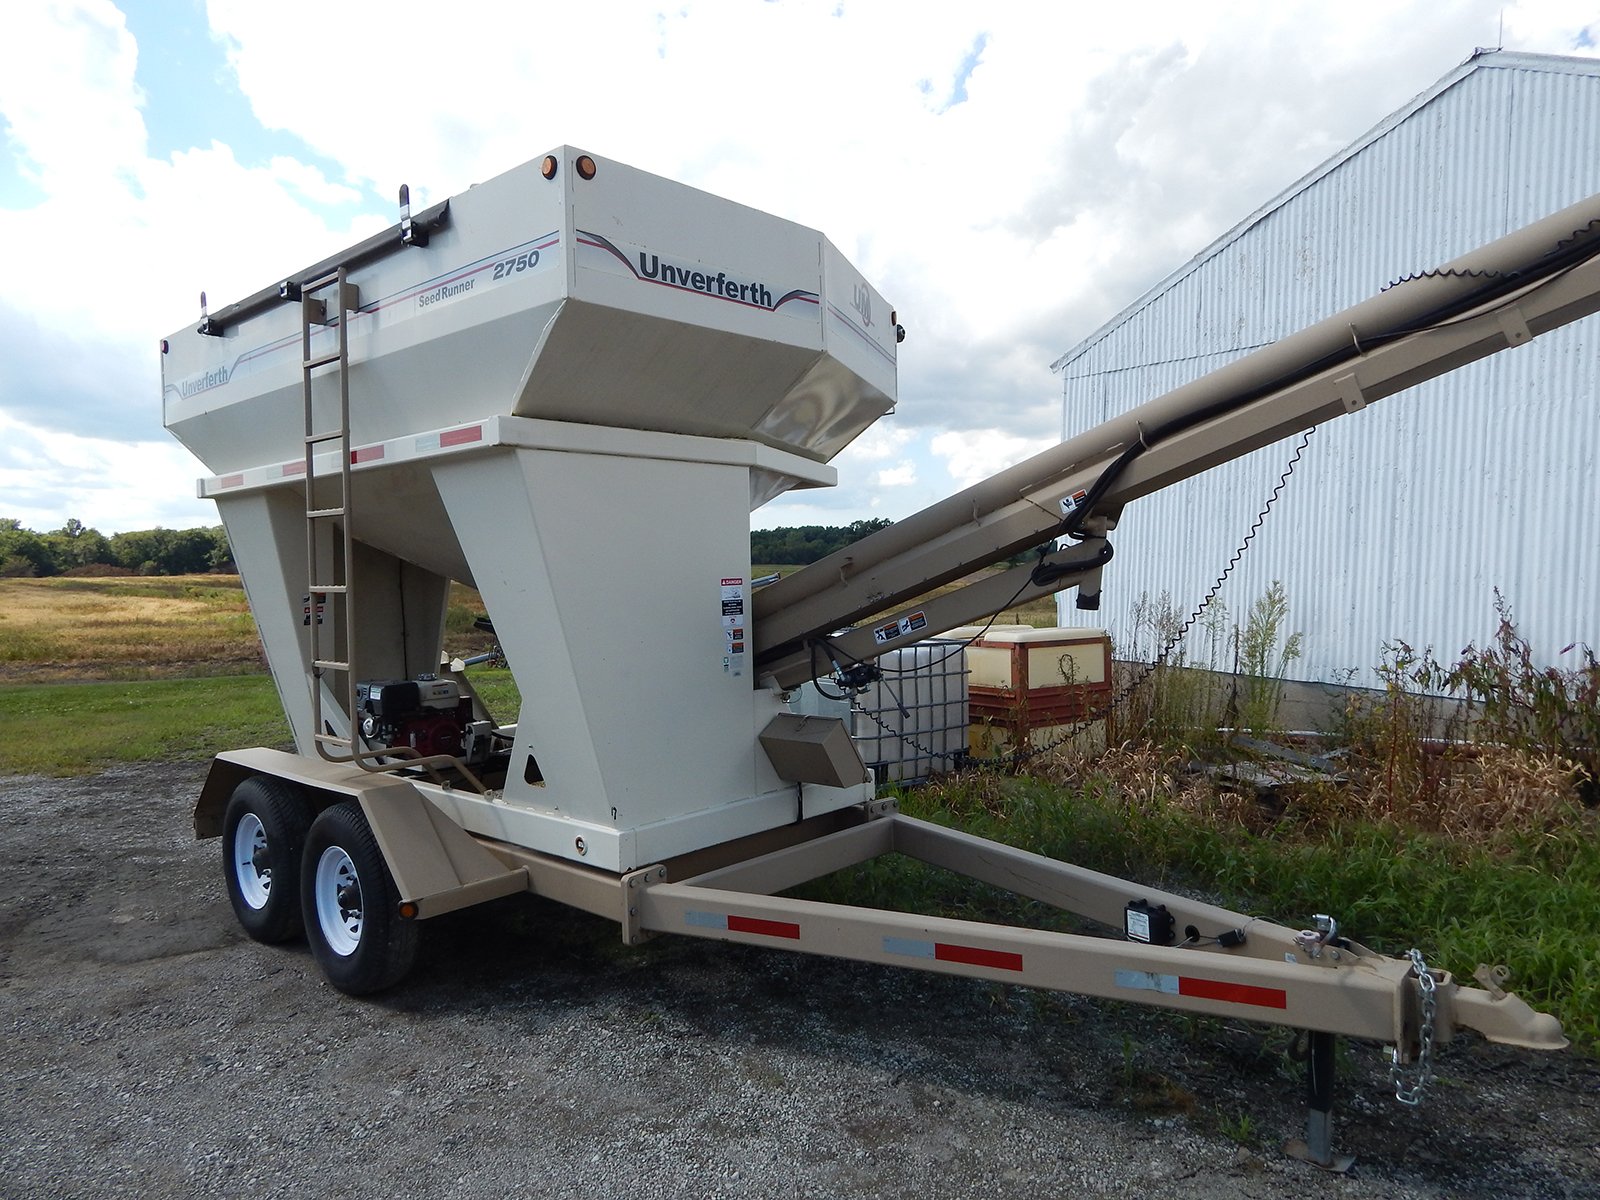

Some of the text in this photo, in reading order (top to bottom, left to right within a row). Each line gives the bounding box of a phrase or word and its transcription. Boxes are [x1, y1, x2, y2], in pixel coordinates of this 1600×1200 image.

[492, 249, 541, 281] 2750
[639, 251, 772, 307] Unverferth
[181, 365, 228, 397] Unverferth
